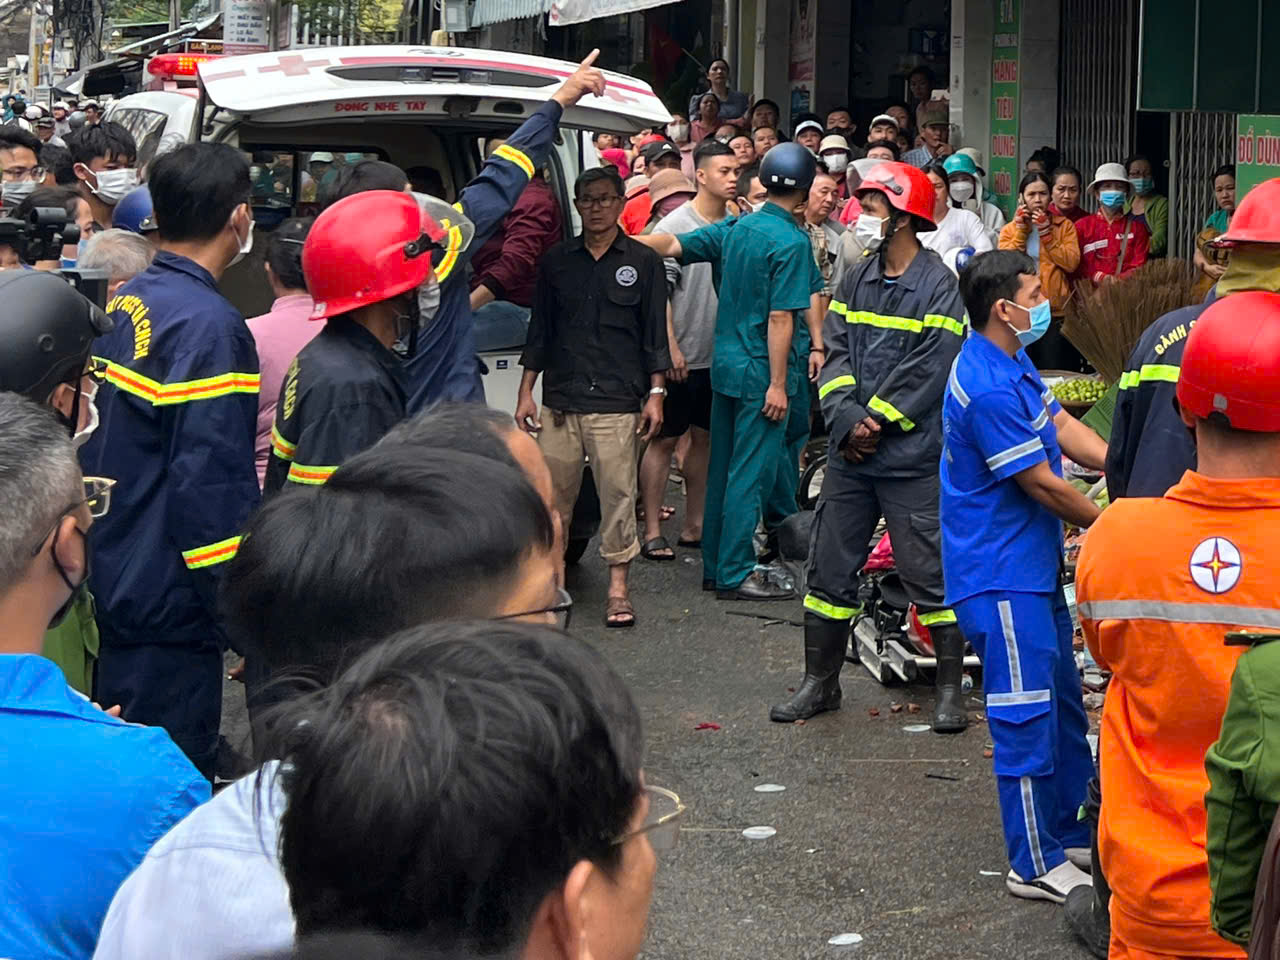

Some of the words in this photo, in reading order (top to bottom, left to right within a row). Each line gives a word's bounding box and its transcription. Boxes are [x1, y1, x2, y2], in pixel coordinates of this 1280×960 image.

[405, 101, 428, 112] TAY
[1237, 125, 1254, 164] ĐỒ
[1154, 323, 1188, 356] CẢNH
